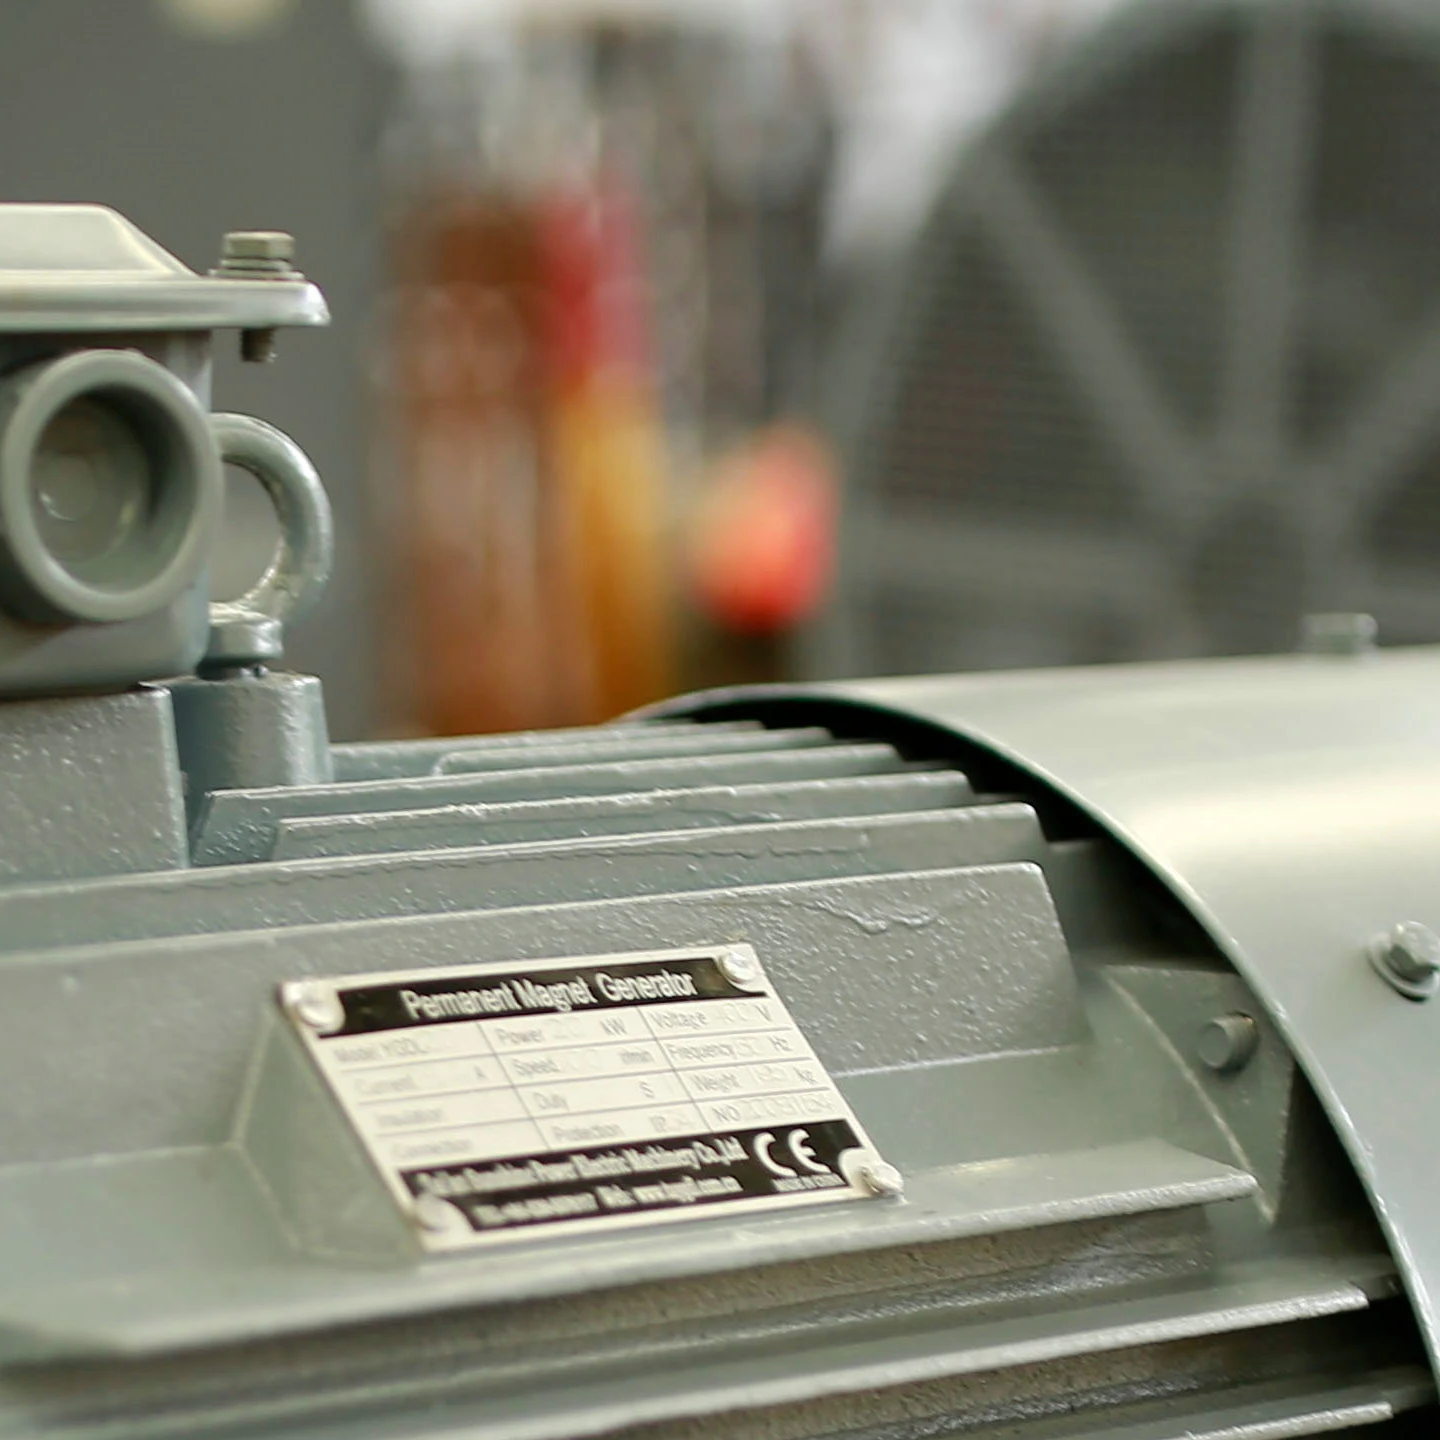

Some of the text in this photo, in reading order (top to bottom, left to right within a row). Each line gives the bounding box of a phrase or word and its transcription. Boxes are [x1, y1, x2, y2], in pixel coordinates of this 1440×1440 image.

[400, 969, 698, 1020] Permanent Magnet Generator
[649, 1011, 709, 1031] Voltage
[753, 1004, 774, 1023] V
[495, 1026, 546, 1045] Power
[665, 1041, 736, 1062] Frequency
[766, 1035, 794, 1053] Hz
[512, 1054, 562, 1079] Speed
[690, 1072, 743, 1093] Weight
[533, 1091, 571, 1112] Duty
[753, 1129, 831, 1177] CE
